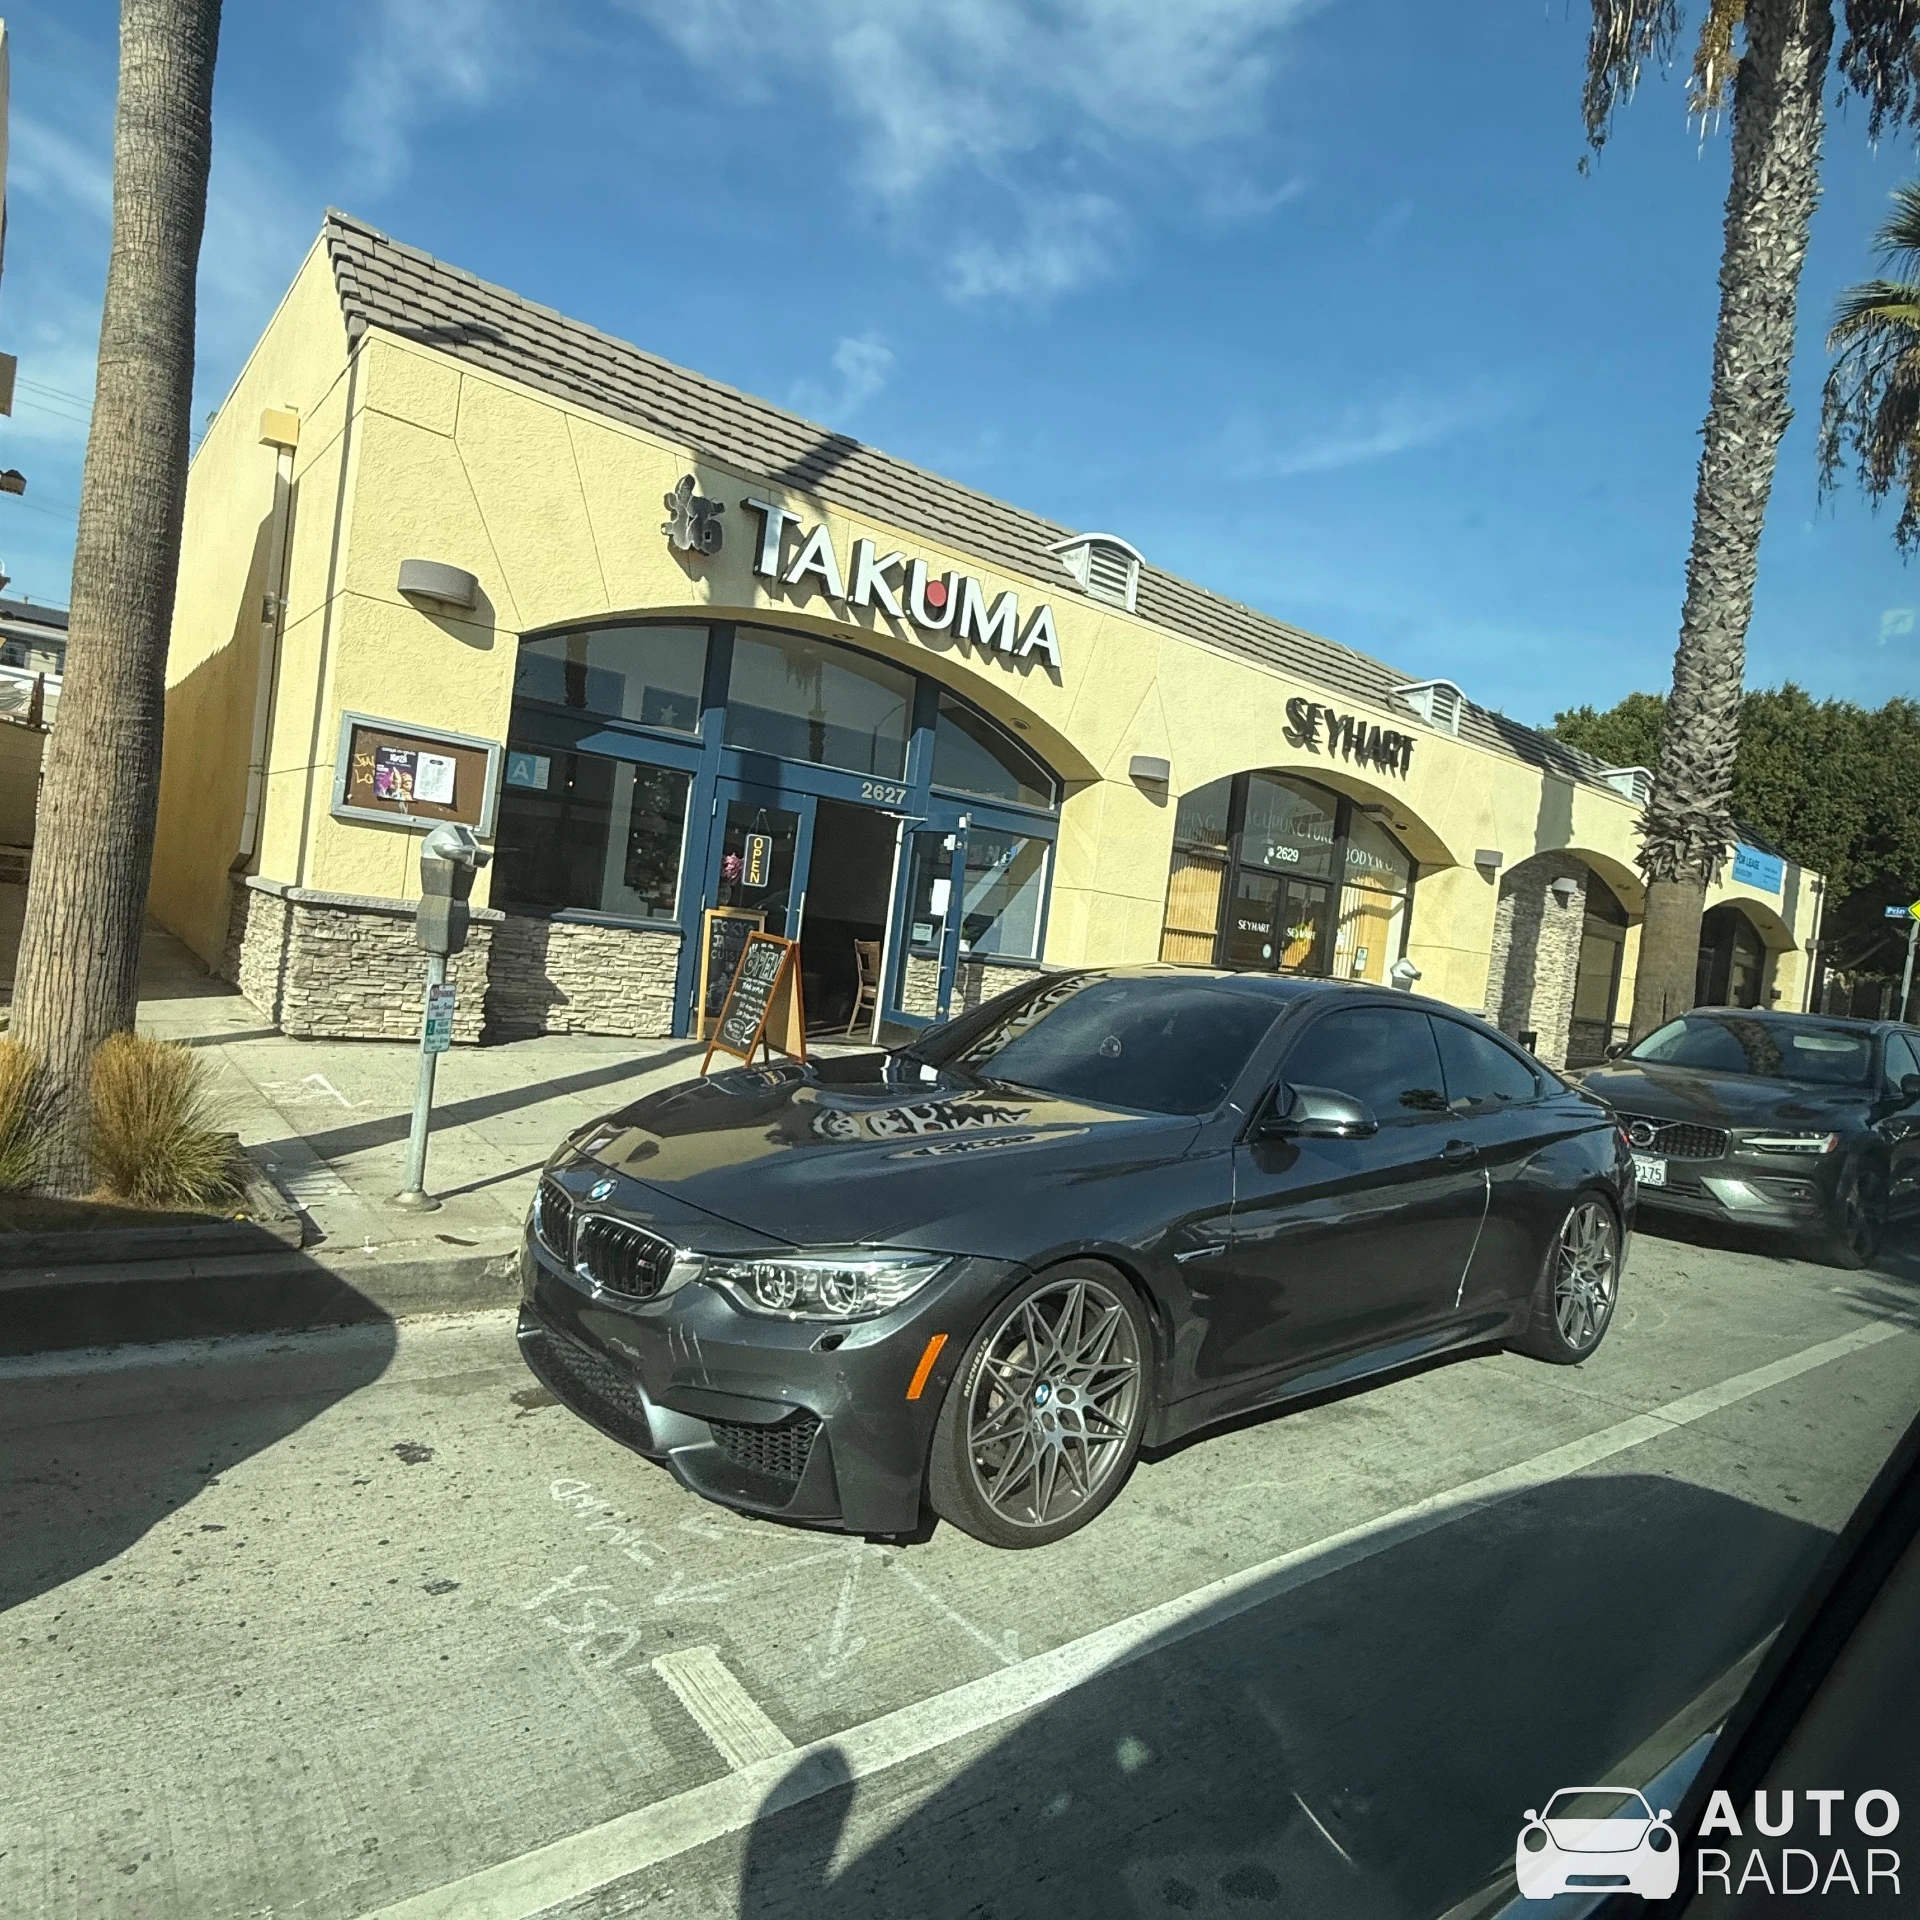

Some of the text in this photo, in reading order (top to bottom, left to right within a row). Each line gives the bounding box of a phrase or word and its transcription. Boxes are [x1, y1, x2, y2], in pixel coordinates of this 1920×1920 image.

[740, 497, 1062, 668] TAKUMA
[1281, 697, 1418, 775] SEYHART
[512, 760, 529, 780] A
[861, 781, 907, 805] 2627
[750, 837, 763, 884] OPEN
[1275, 846, 1299, 862] 2629
[1345, 847, 1397, 873] BODYWO
[1887, 907, 1906, 915] Prin
[1238, 919, 1270, 934] SEYHART
[711, 951, 740, 960] CUIS
[744, 950, 784, 981] OPEN
[963, 1337, 989, 1397] MICHELIN
